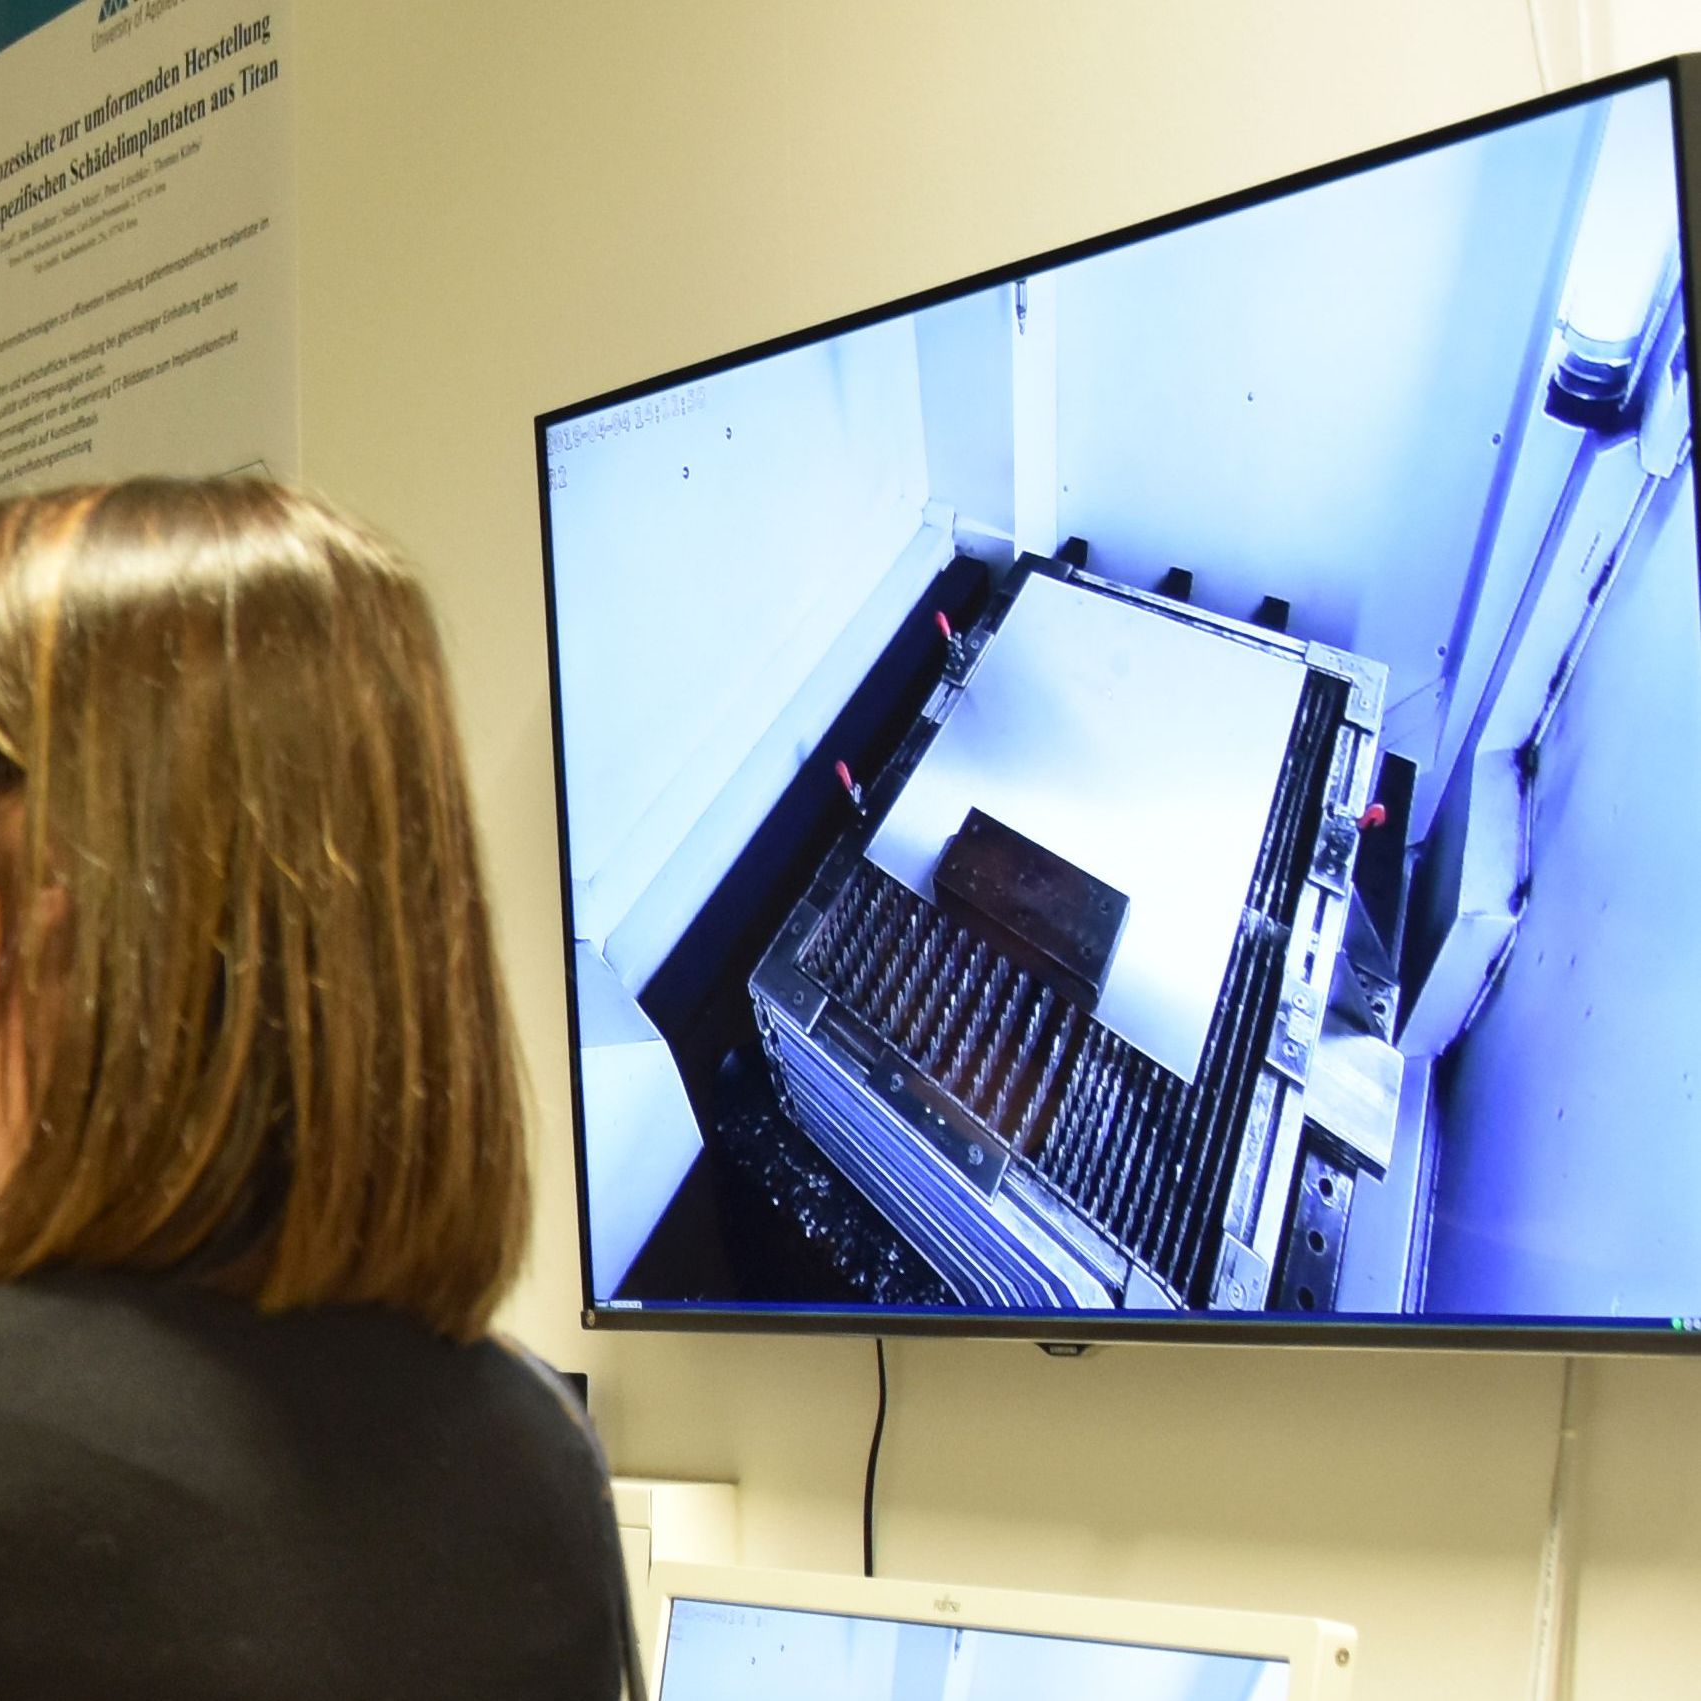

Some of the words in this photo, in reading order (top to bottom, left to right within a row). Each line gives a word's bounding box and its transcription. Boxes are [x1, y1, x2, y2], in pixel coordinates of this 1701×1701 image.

[59, 116, 81, 147] zur
[84, 63, 180, 138] umformenden
[185, 14, 272, 79] Herstellung
[70, 99, 206, 188] Schädelimplantaten
[210, 85, 236, 114] aus
[239, 58, 280, 98] Titan
